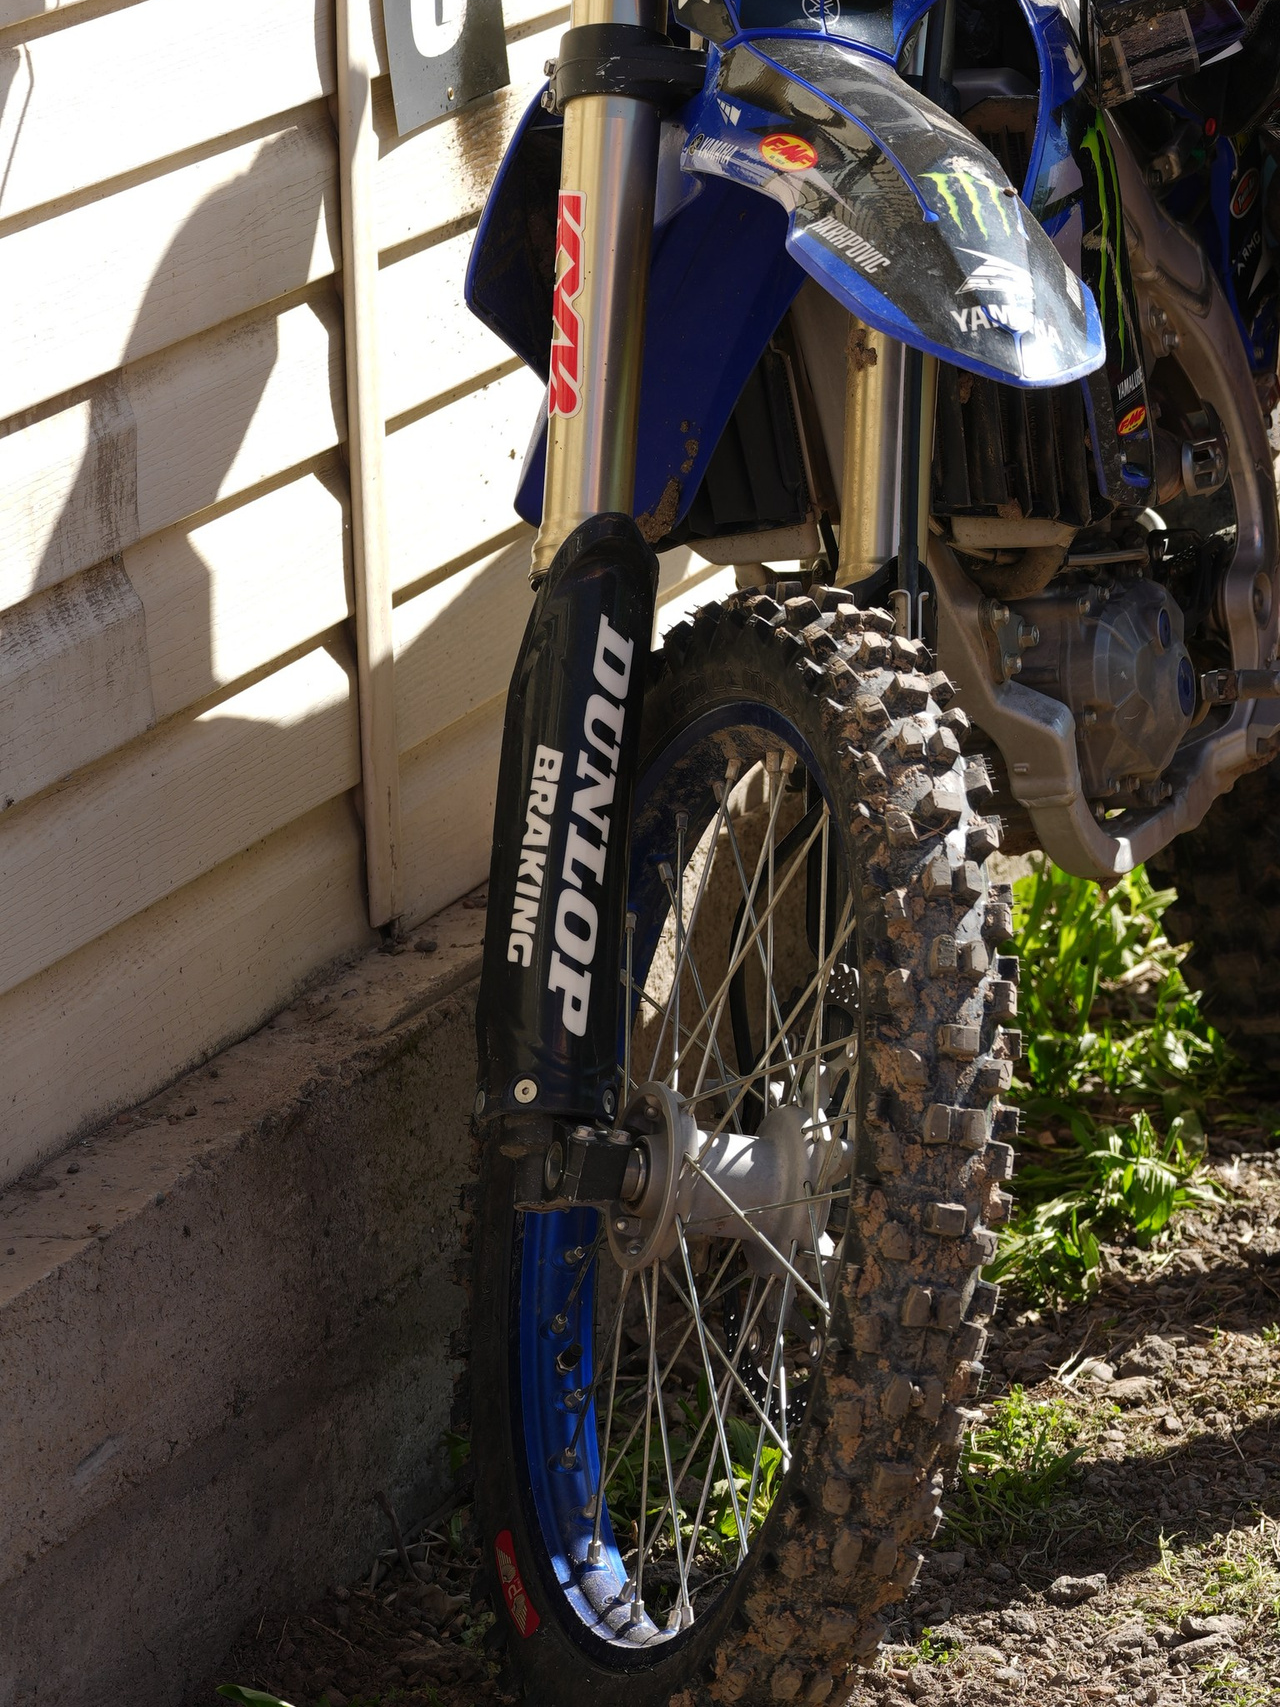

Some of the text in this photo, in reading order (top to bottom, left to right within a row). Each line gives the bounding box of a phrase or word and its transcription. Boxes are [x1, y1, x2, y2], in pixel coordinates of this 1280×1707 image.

[697, 136, 738, 164] YAMAHA
[763, 137, 814, 165] FMF
[805, 215, 891, 275] AKRAPOVIC
[507, 743, 564, 968] BRAKING
[548, 613, 637, 1038] DUNLOP
